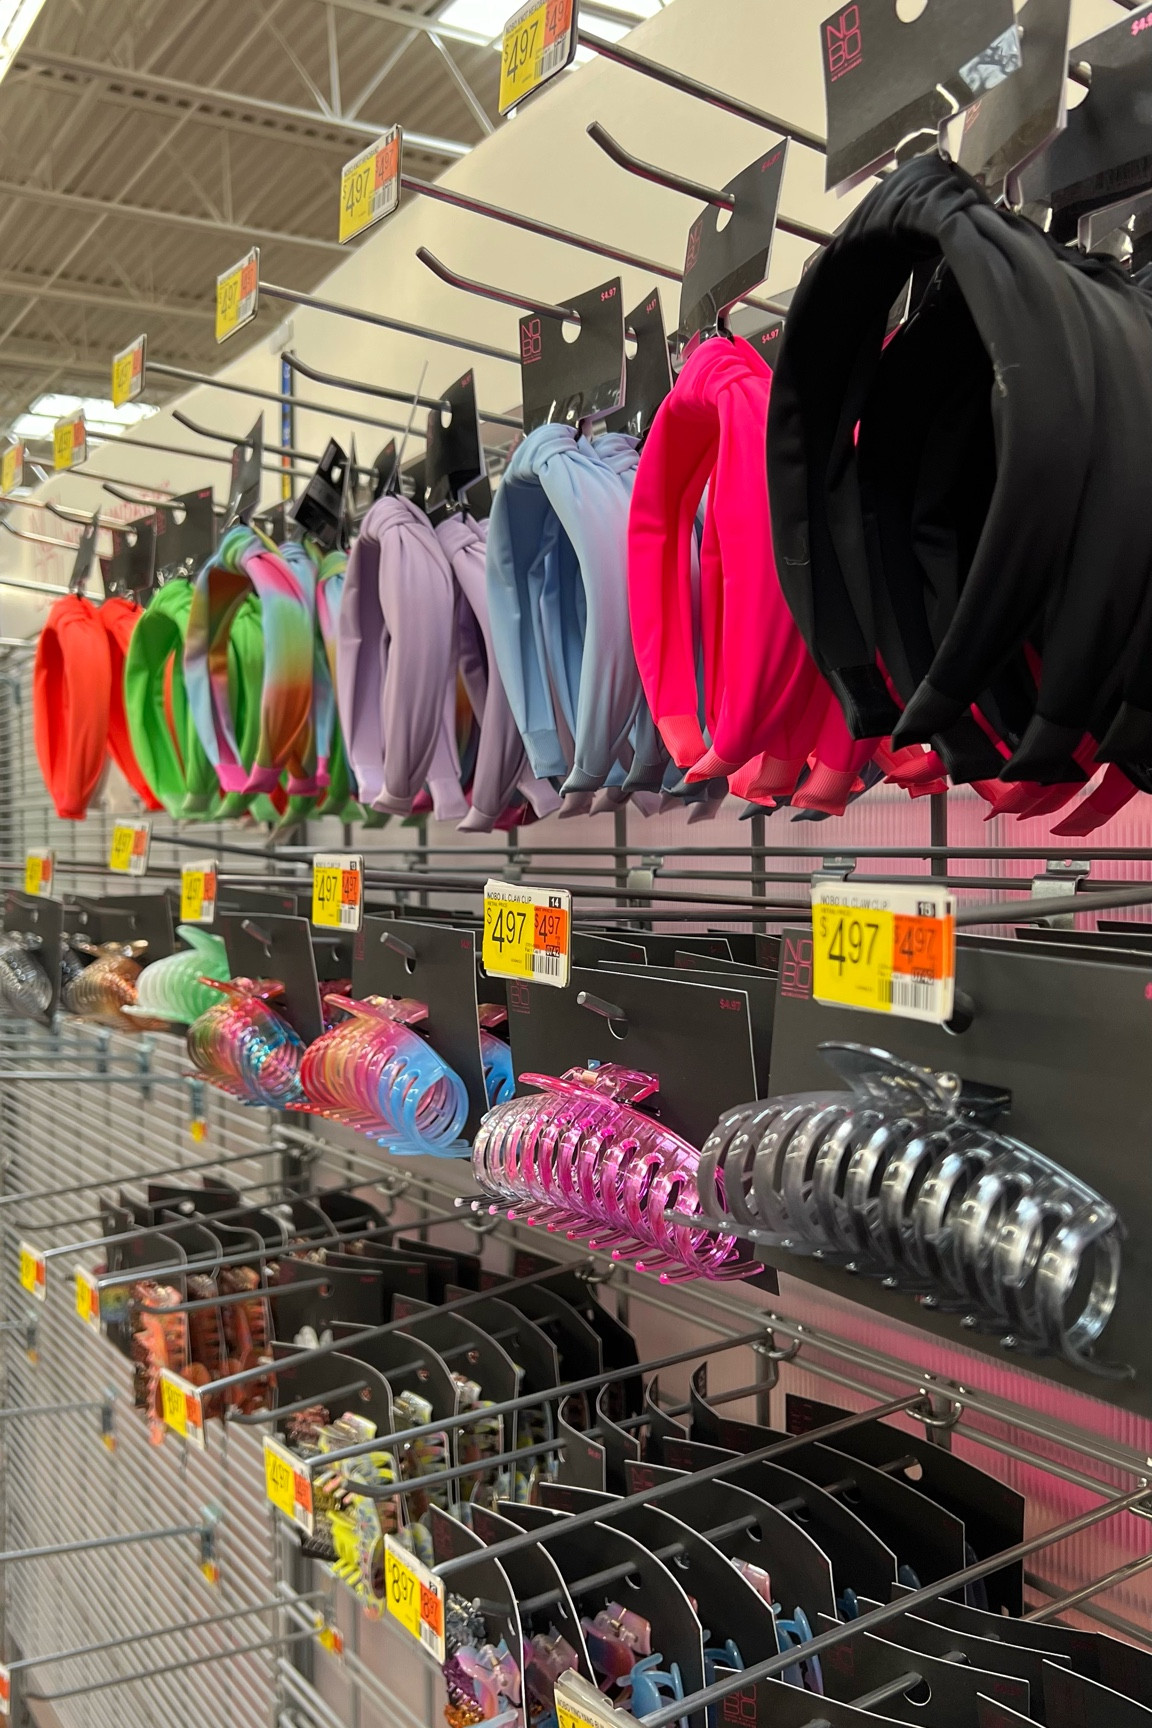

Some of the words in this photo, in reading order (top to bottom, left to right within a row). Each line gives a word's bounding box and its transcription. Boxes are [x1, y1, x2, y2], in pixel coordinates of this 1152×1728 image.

[826, 4, 859, 49] NO
[504, 20, 539, 83] $497
[829, 28, 861, 72] BO
[343, 167, 370, 217] $497
[600, 287, 617, 302] $4.97
[521, 318, 541, 338] NO
[761, 329, 780, 344] $4.97
[522, 335, 542, 358] BO
[316, 874, 338, 911] $497
[487, 892, 501, 901] NOBO
[507, 894, 521, 903] CLAW
[521, 895, 532, 905] CLIP
[551, 897, 560, 908] 14
[820, 895, 840, 906] NOBO
[850, 897, 871, 909] CLAW
[871, 899, 888, 912] CLIP
[486, 907, 527, 953] $497
[534, 913, 561, 944] $497
[784, 937, 812, 966] NO
[820, 916, 879, 977] $497
[895, 925, 936, 964] $497
[781, 961, 812, 990] BO
[720, 999, 741, 1012] $4.97
